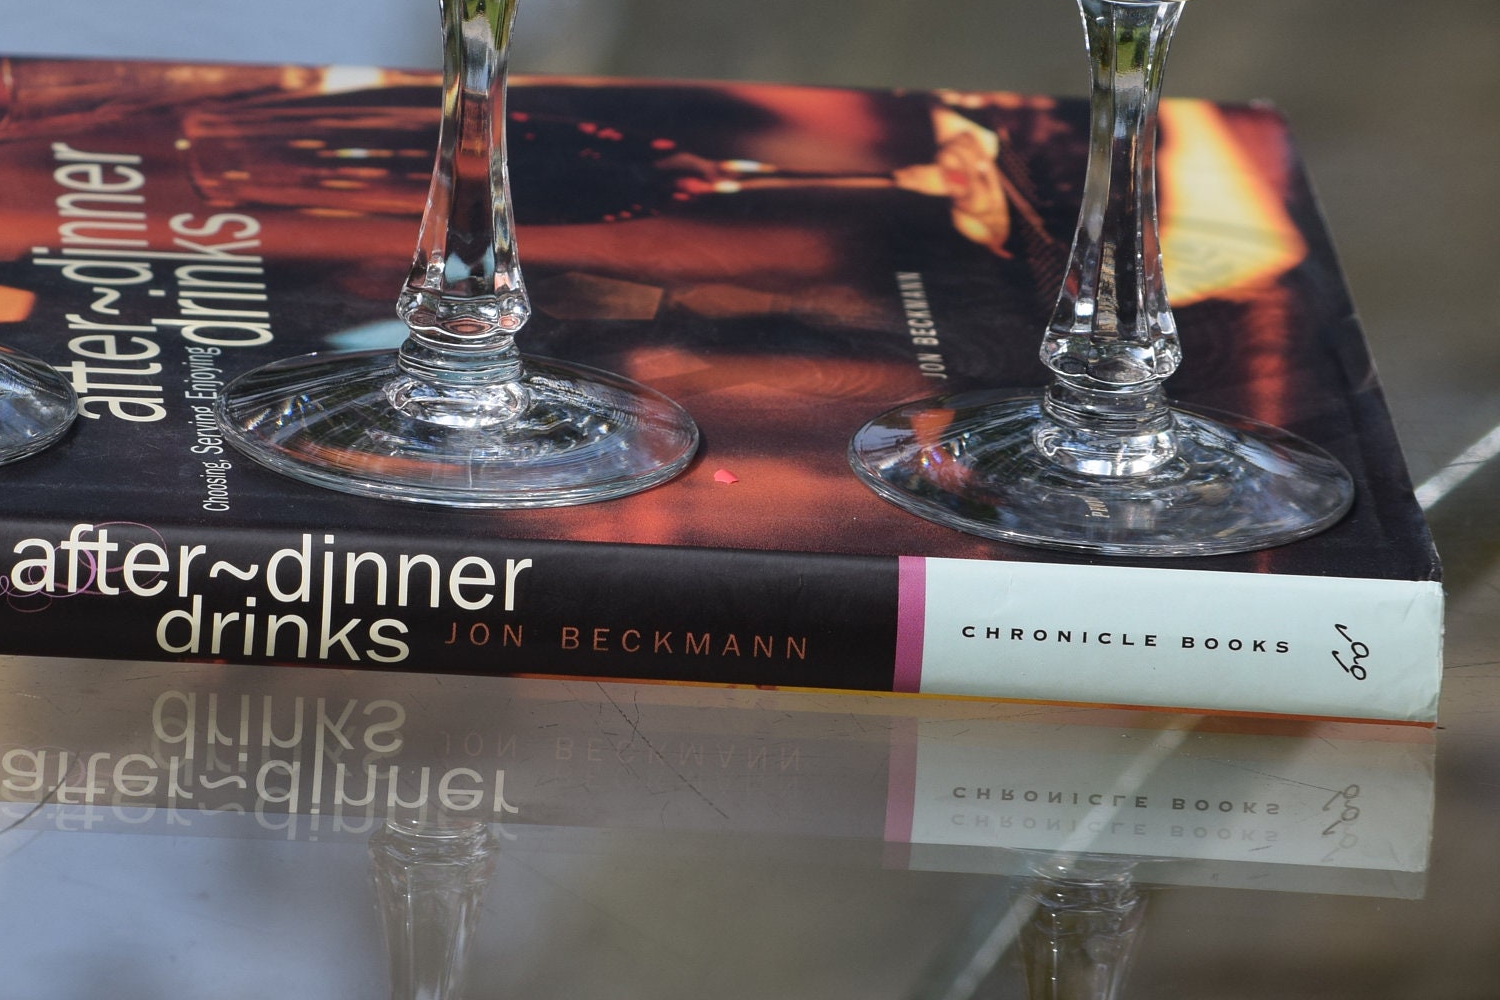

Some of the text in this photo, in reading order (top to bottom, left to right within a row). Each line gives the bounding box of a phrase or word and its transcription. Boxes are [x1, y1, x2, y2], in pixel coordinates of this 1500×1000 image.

[149, 213, 274, 347] drinks
[895, 272, 948, 379] JON BECKMANN
[182, 346, 225, 399] Enjoying
[200, 459, 232, 512] Choosing,
[156, 596, 808, 664] drinks JON BECKMANN
[961, 625, 1290, 654] CHRONICLE BOOKS
